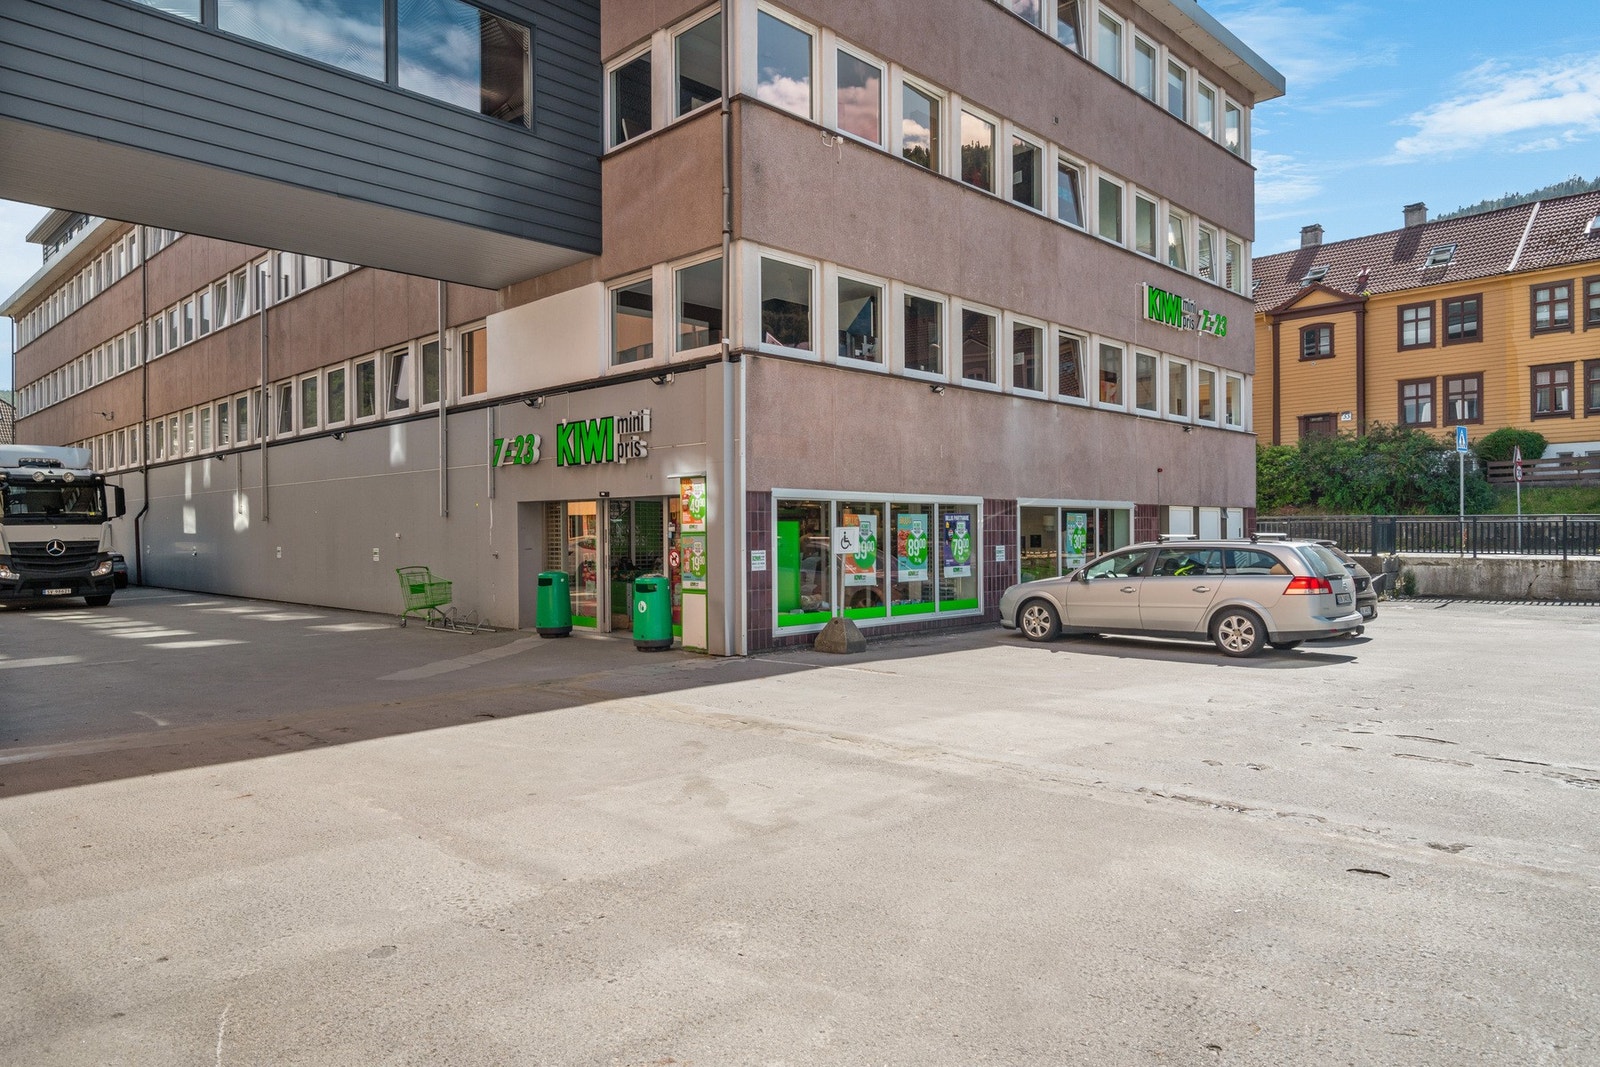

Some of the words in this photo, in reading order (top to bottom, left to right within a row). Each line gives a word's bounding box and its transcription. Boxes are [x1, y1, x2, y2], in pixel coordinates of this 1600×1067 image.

[1148, 285, 1182, 328] KIWI
[1183, 315, 1195, 329] pris
[617, 409, 644, 434] mini
[492, 434, 535, 467] 7-23
[557, 416, 614, 467] KIWI
[617, 437, 641, 463] pris
